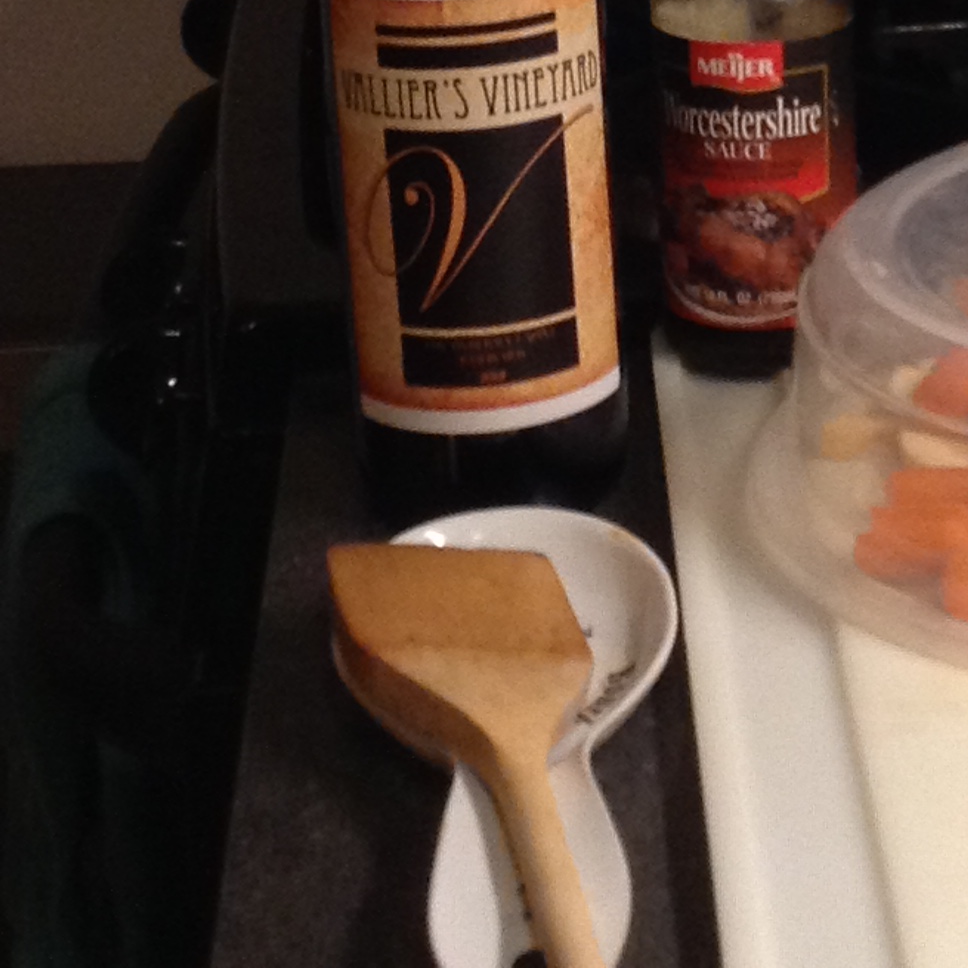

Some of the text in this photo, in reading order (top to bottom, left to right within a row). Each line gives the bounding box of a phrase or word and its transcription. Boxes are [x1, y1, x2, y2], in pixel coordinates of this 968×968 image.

[697, 52, 774, 83] MEIJER
[341, 50, 599, 120] VALLIER'S VINEYARD
[704, 141, 772, 160] SAUCE
